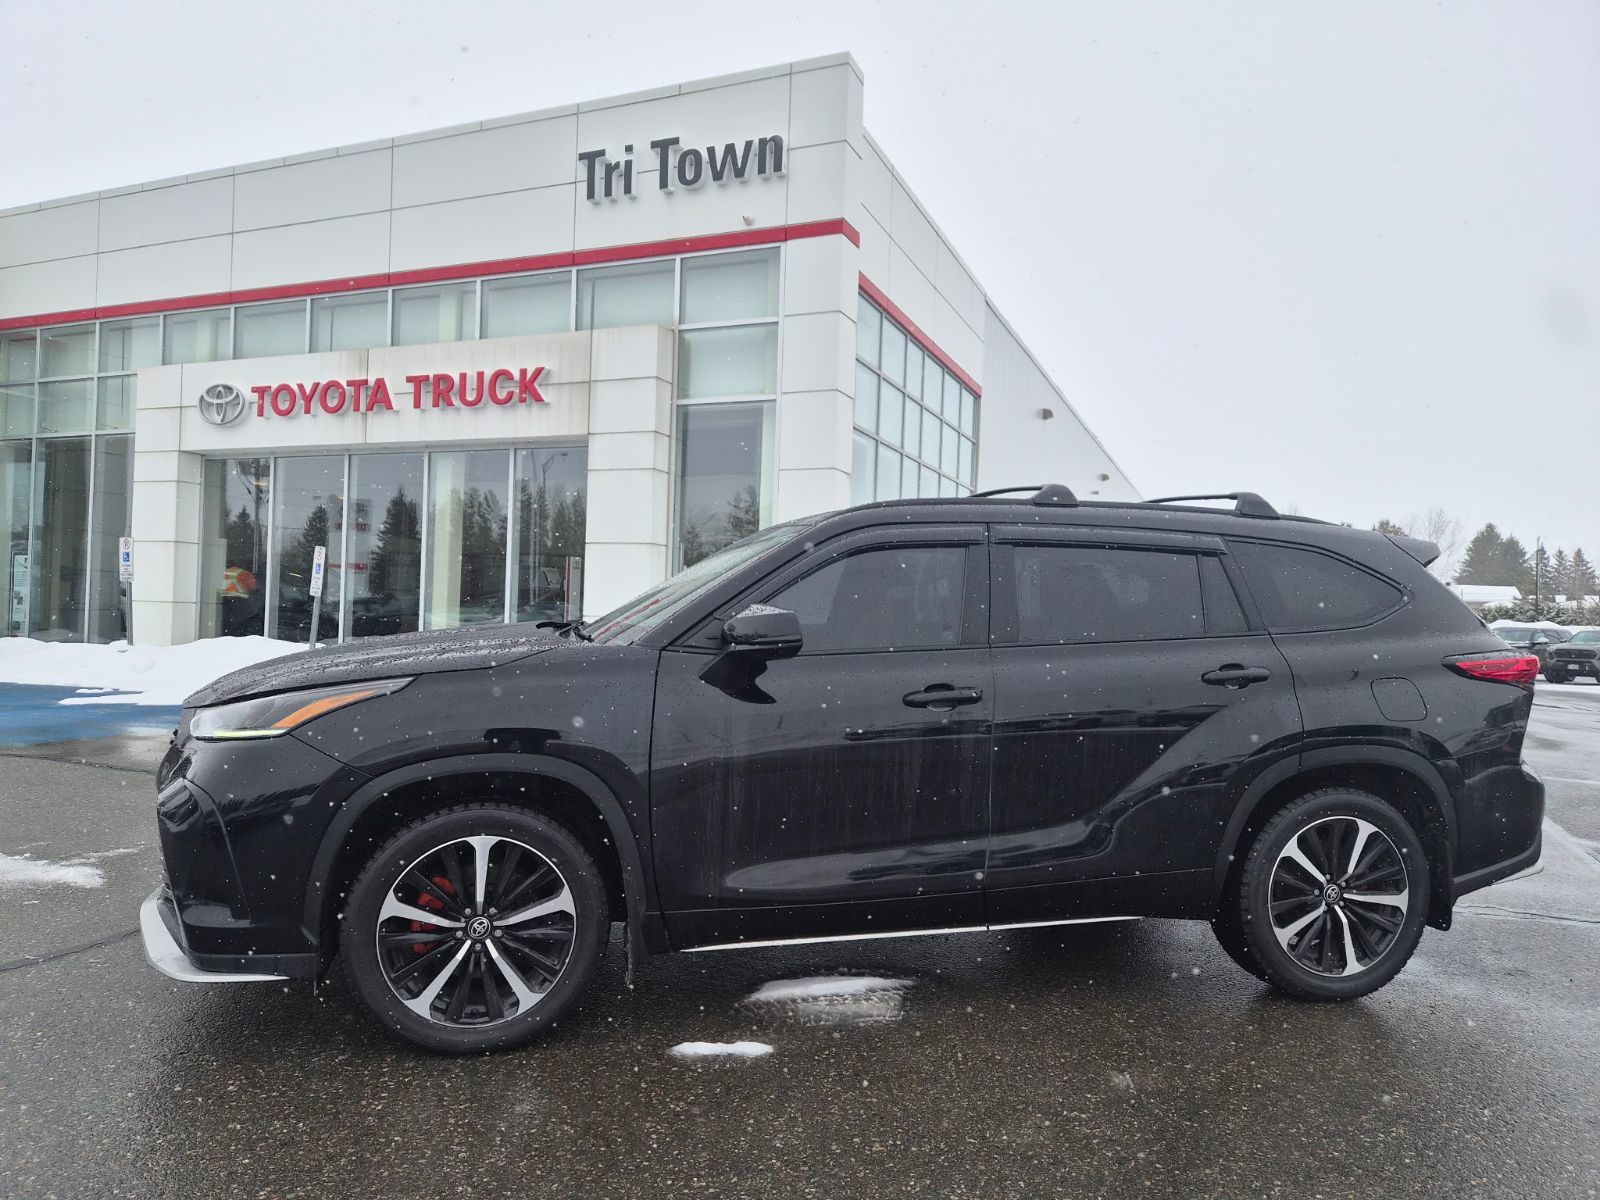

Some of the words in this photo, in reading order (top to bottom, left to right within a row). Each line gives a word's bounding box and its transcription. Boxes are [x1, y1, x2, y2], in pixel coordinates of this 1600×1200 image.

[578, 144, 635, 201] Tri
[651, 135, 784, 190] Town
[251, 377, 394, 418] TOYOTA
[405, 366, 547, 409] TRUCK
